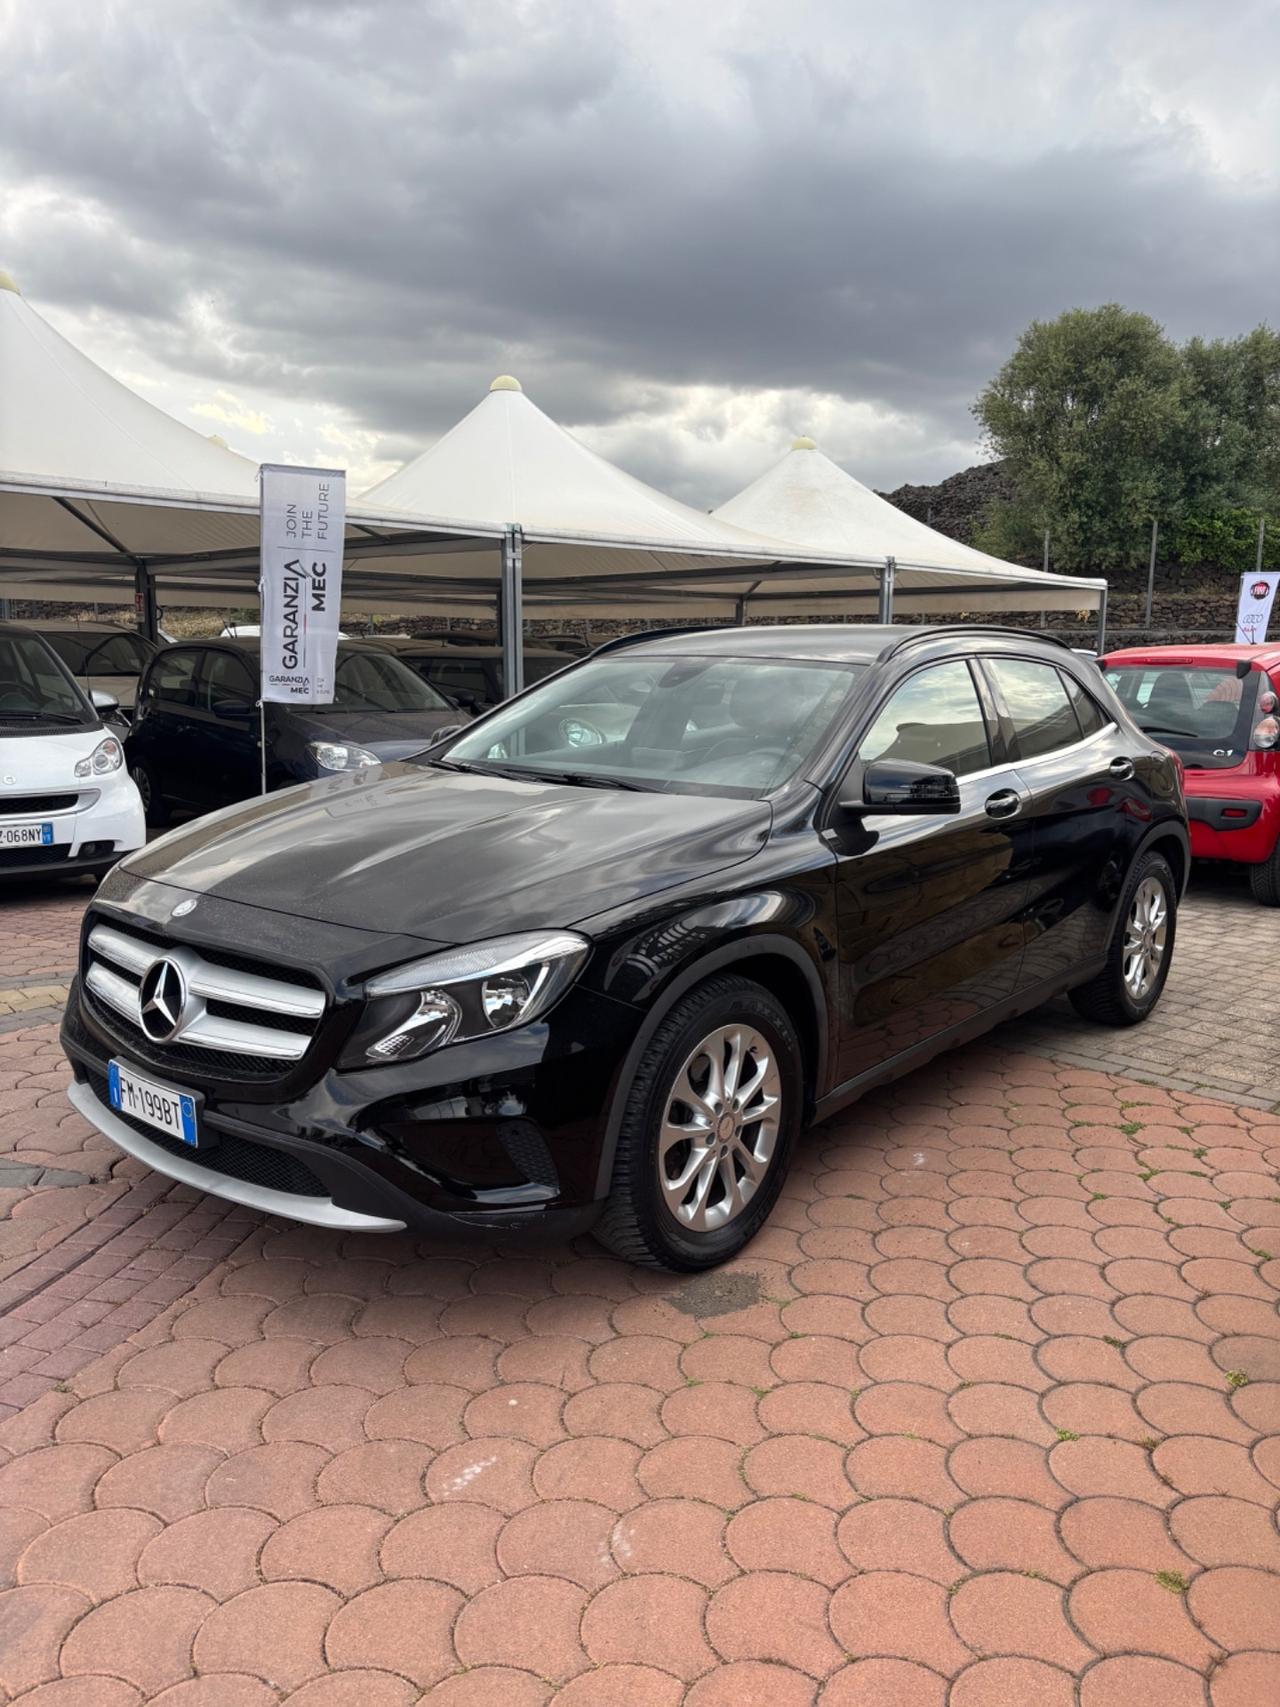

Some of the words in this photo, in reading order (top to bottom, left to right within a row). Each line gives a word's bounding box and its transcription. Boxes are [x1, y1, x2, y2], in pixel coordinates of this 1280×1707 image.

[286, 503, 297, 539] JOIN
[301, 510, 313, 539] THE
[317, 483, 329, 540] FUTURE
[312, 562, 326, 612] MEC
[282, 559, 306, 670] GARANZIA
[269, 675, 310, 686] GARANZIA
[290, 687, 309, 695] MEC
